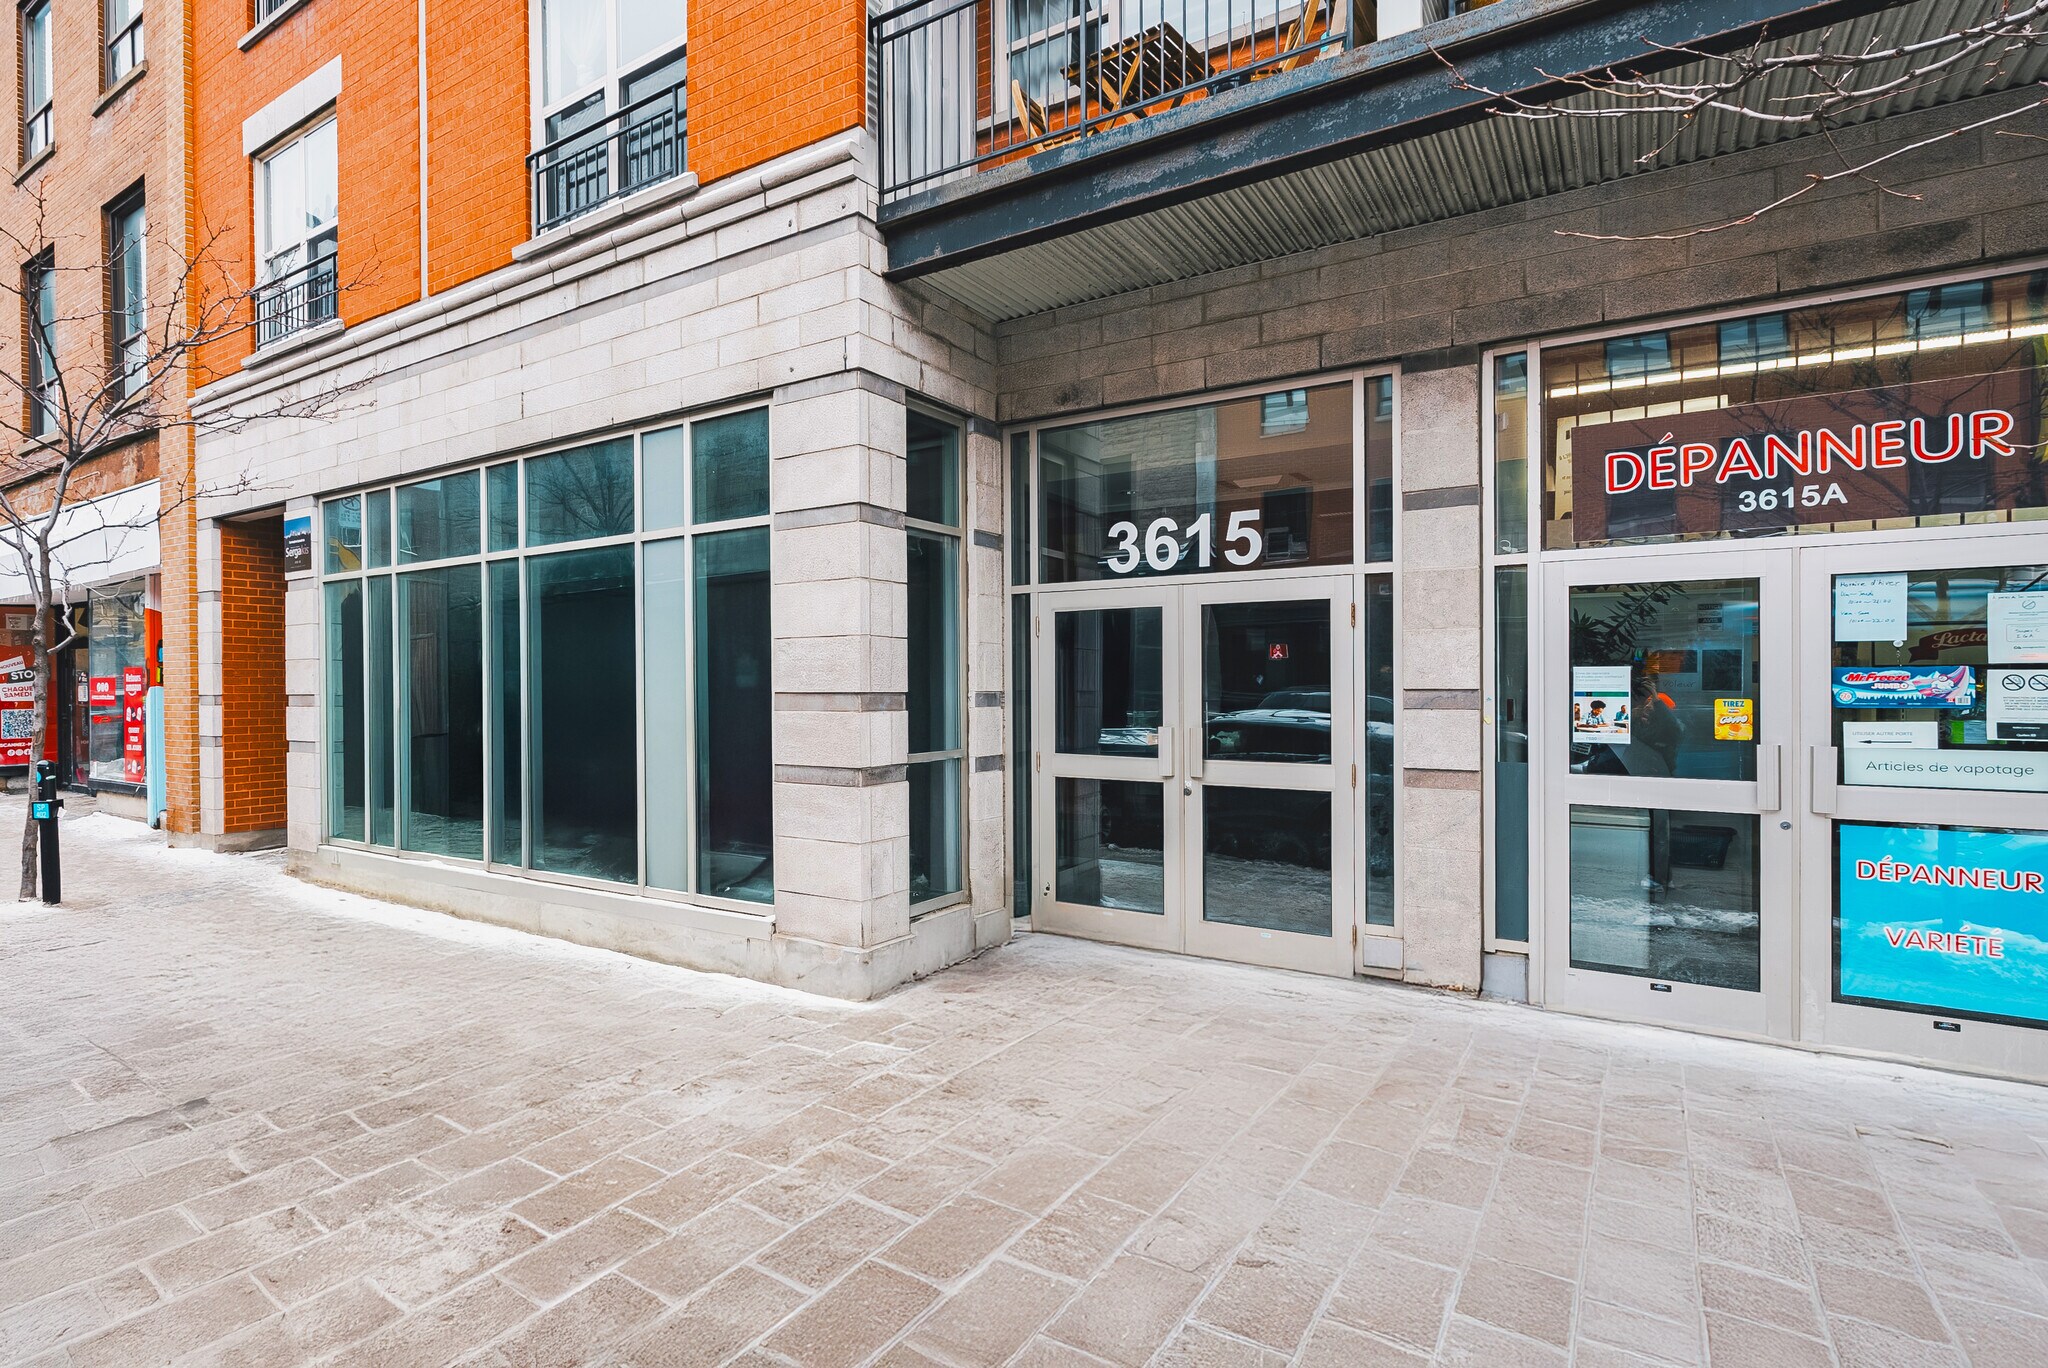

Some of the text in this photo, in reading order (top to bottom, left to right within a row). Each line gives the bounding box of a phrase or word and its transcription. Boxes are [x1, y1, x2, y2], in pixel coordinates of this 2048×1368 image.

[1605, 410, 2015, 495] DÉPANNEUR
[1738, 483, 1848, 512] 3615A
[1107, 509, 1262, 573] 3615
[11, 670, 34, 680] STO
[1866, 761, 2035, 778] Articles de vapotage
[1856, 855, 2044, 893] DÉPANNEUR
[1885, 926, 2004, 959] VARIÉTÉ
